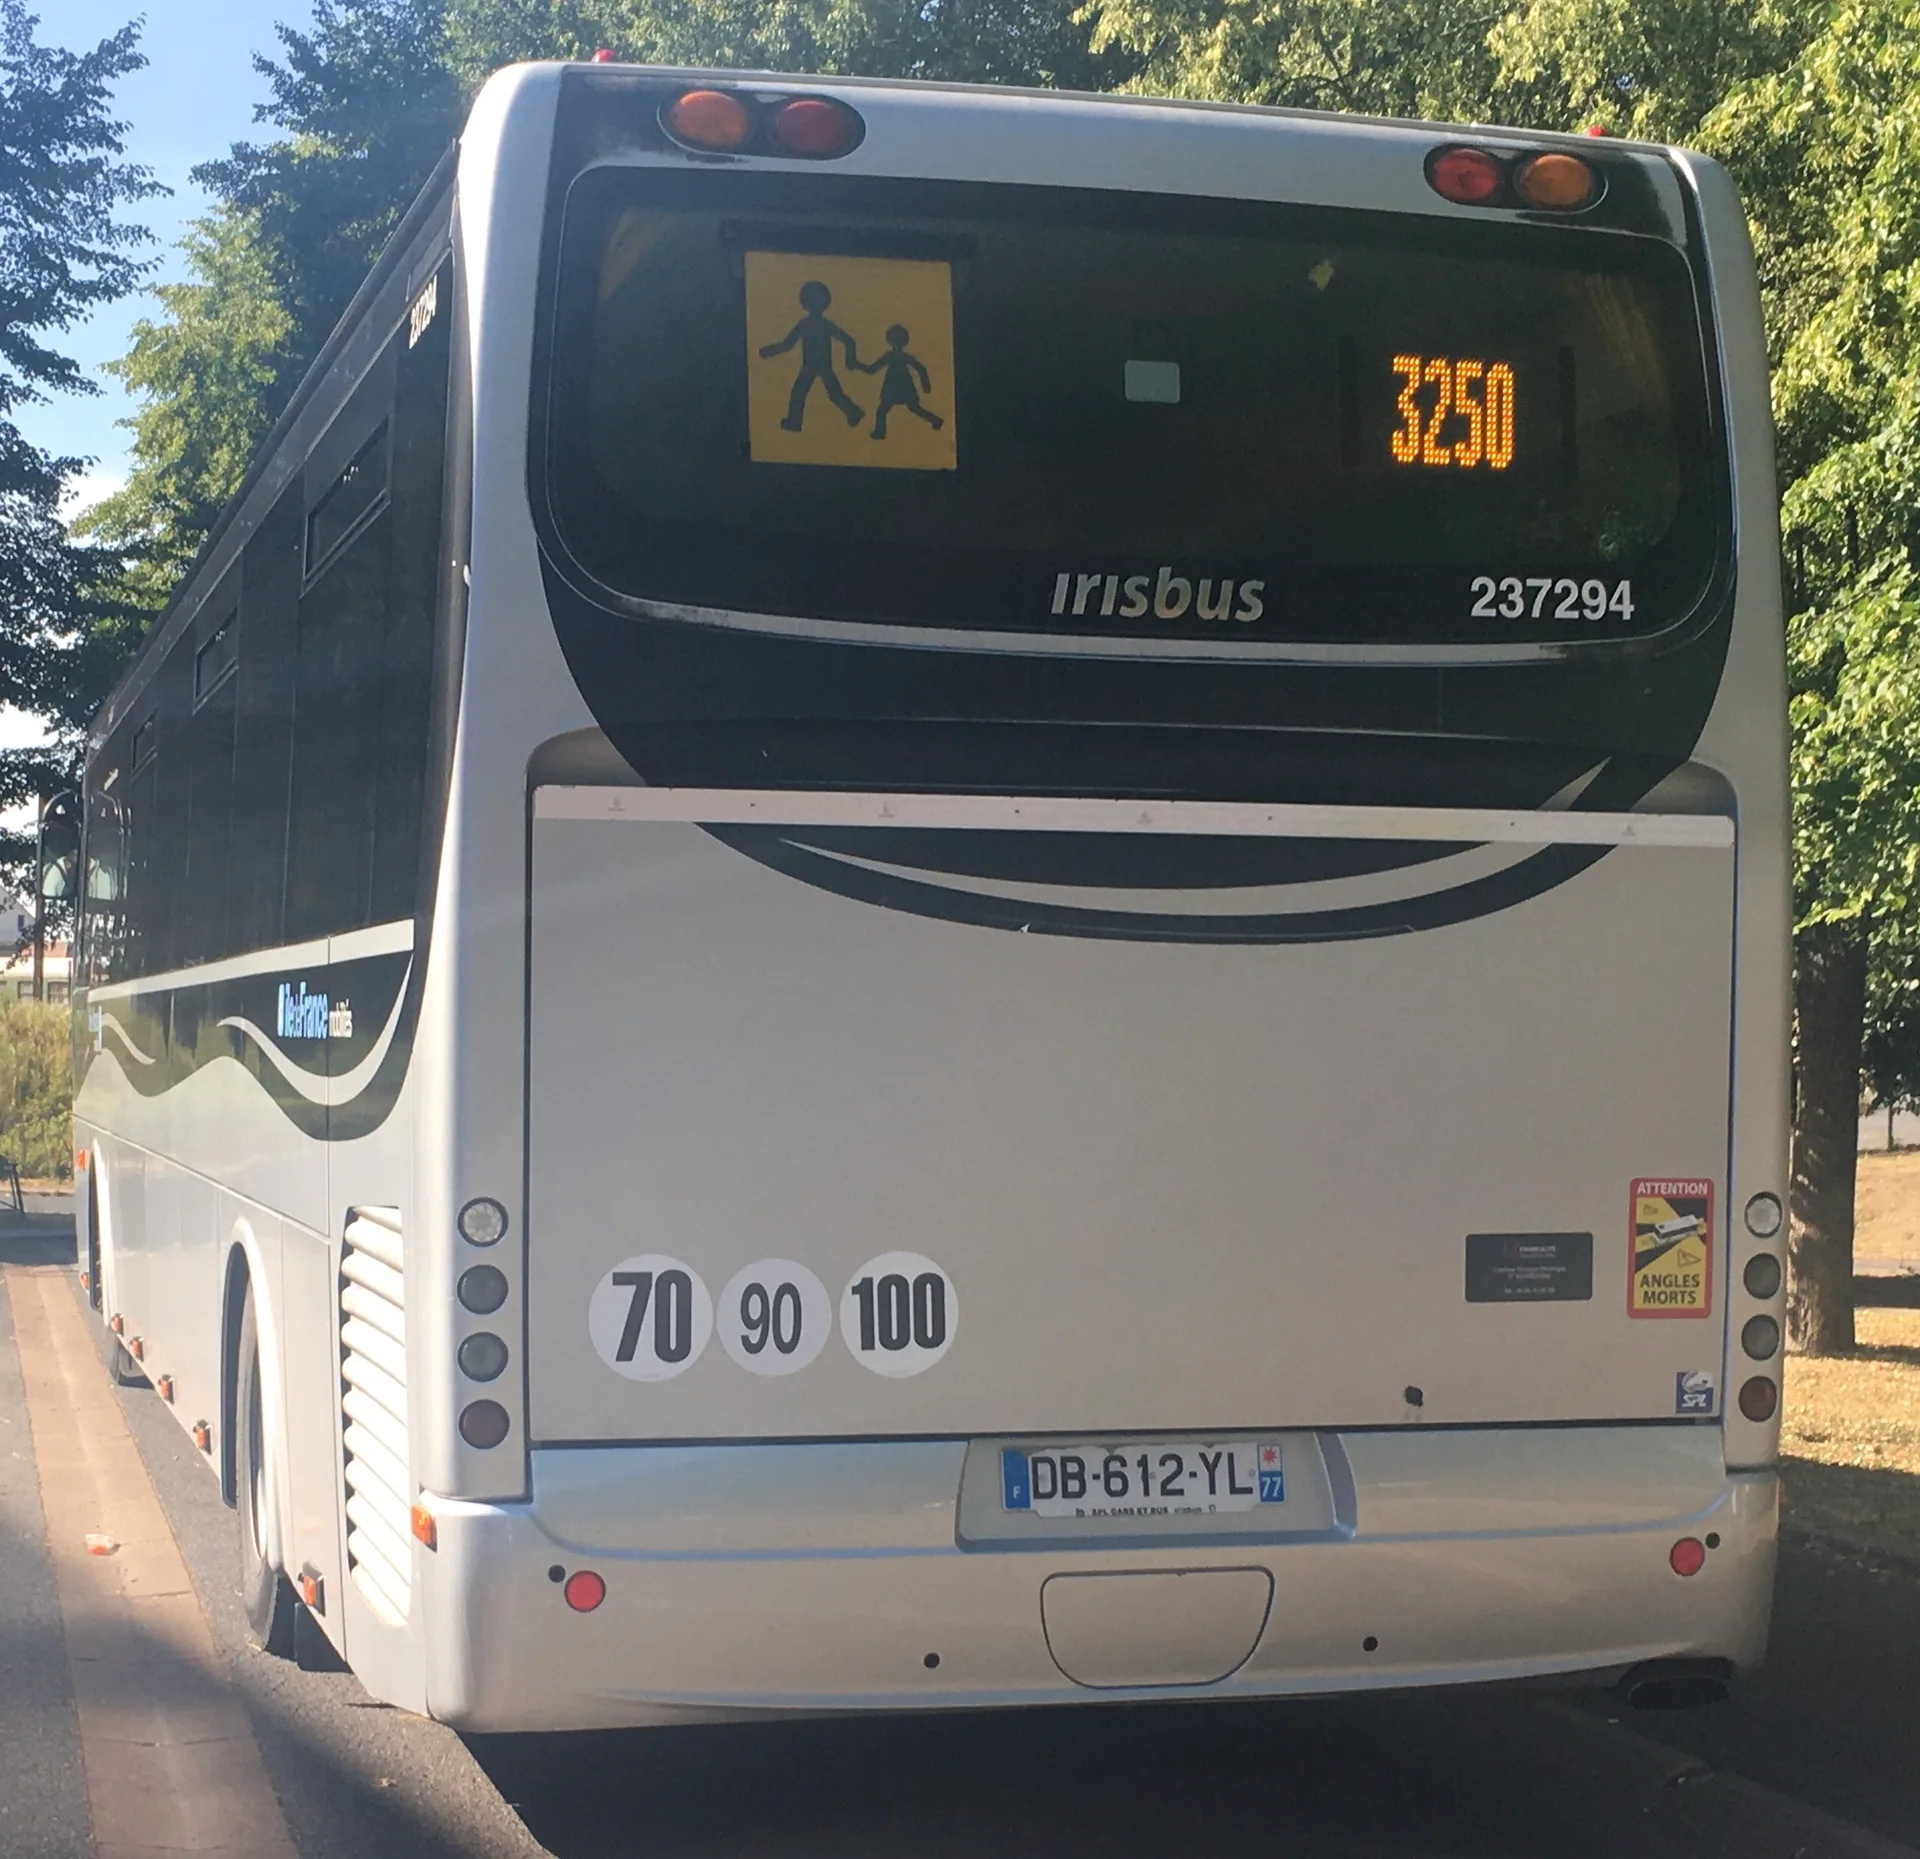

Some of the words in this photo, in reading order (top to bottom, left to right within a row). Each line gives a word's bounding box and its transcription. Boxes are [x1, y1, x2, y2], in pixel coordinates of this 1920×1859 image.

[1392, 354, 1515, 470] 3250
[1470, 575, 1636, 621] 237294
[1637, 1181, 1708, 1195] ATTENTION
[1640, 1273, 1700, 1289] ANGLES
[1643, 1290, 1697, 1305] MORTS
[612, 1269, 693, 1363] 70
[740, 1281, 802, 1355] 90
[851, 1272, 947, 1351] 100
[1013, 1485, 1021, 1499] F
[1030, 1451, 1254, 1500] DB-612-YL
[1261, 1476, 1282, 1498] 77
